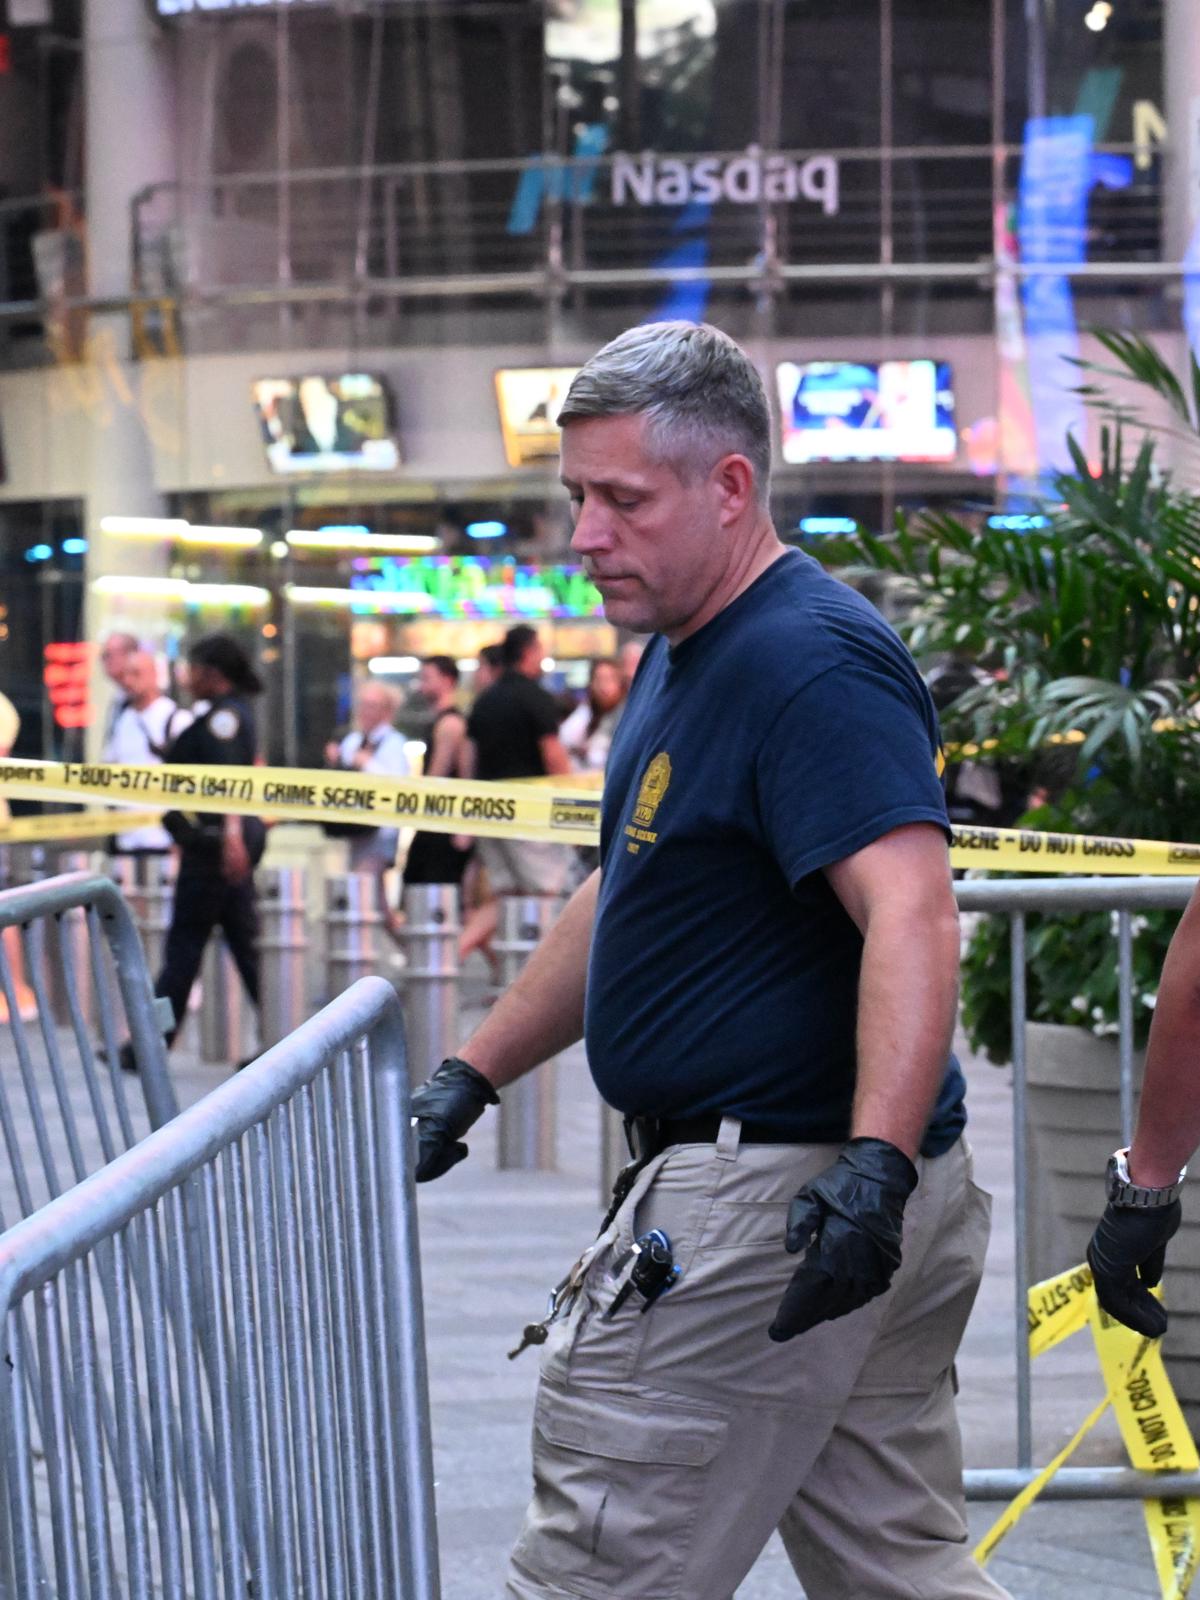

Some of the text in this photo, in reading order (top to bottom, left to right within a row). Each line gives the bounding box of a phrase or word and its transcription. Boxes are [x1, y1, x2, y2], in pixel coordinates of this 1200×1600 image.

[611, 144, 840, 217] Nasdaq
[63, 763, 196, 795] 1-800-577-TIPS
[200, 775, 254, 800] (8477)
[263, 782, 317, 807] CRIME
[321, 785, 376, 810] SCENE
[396, 792, 419, 814] DO
[424, 795, 456, 819] NOT
[460, 796, 517, 822] CROSS
